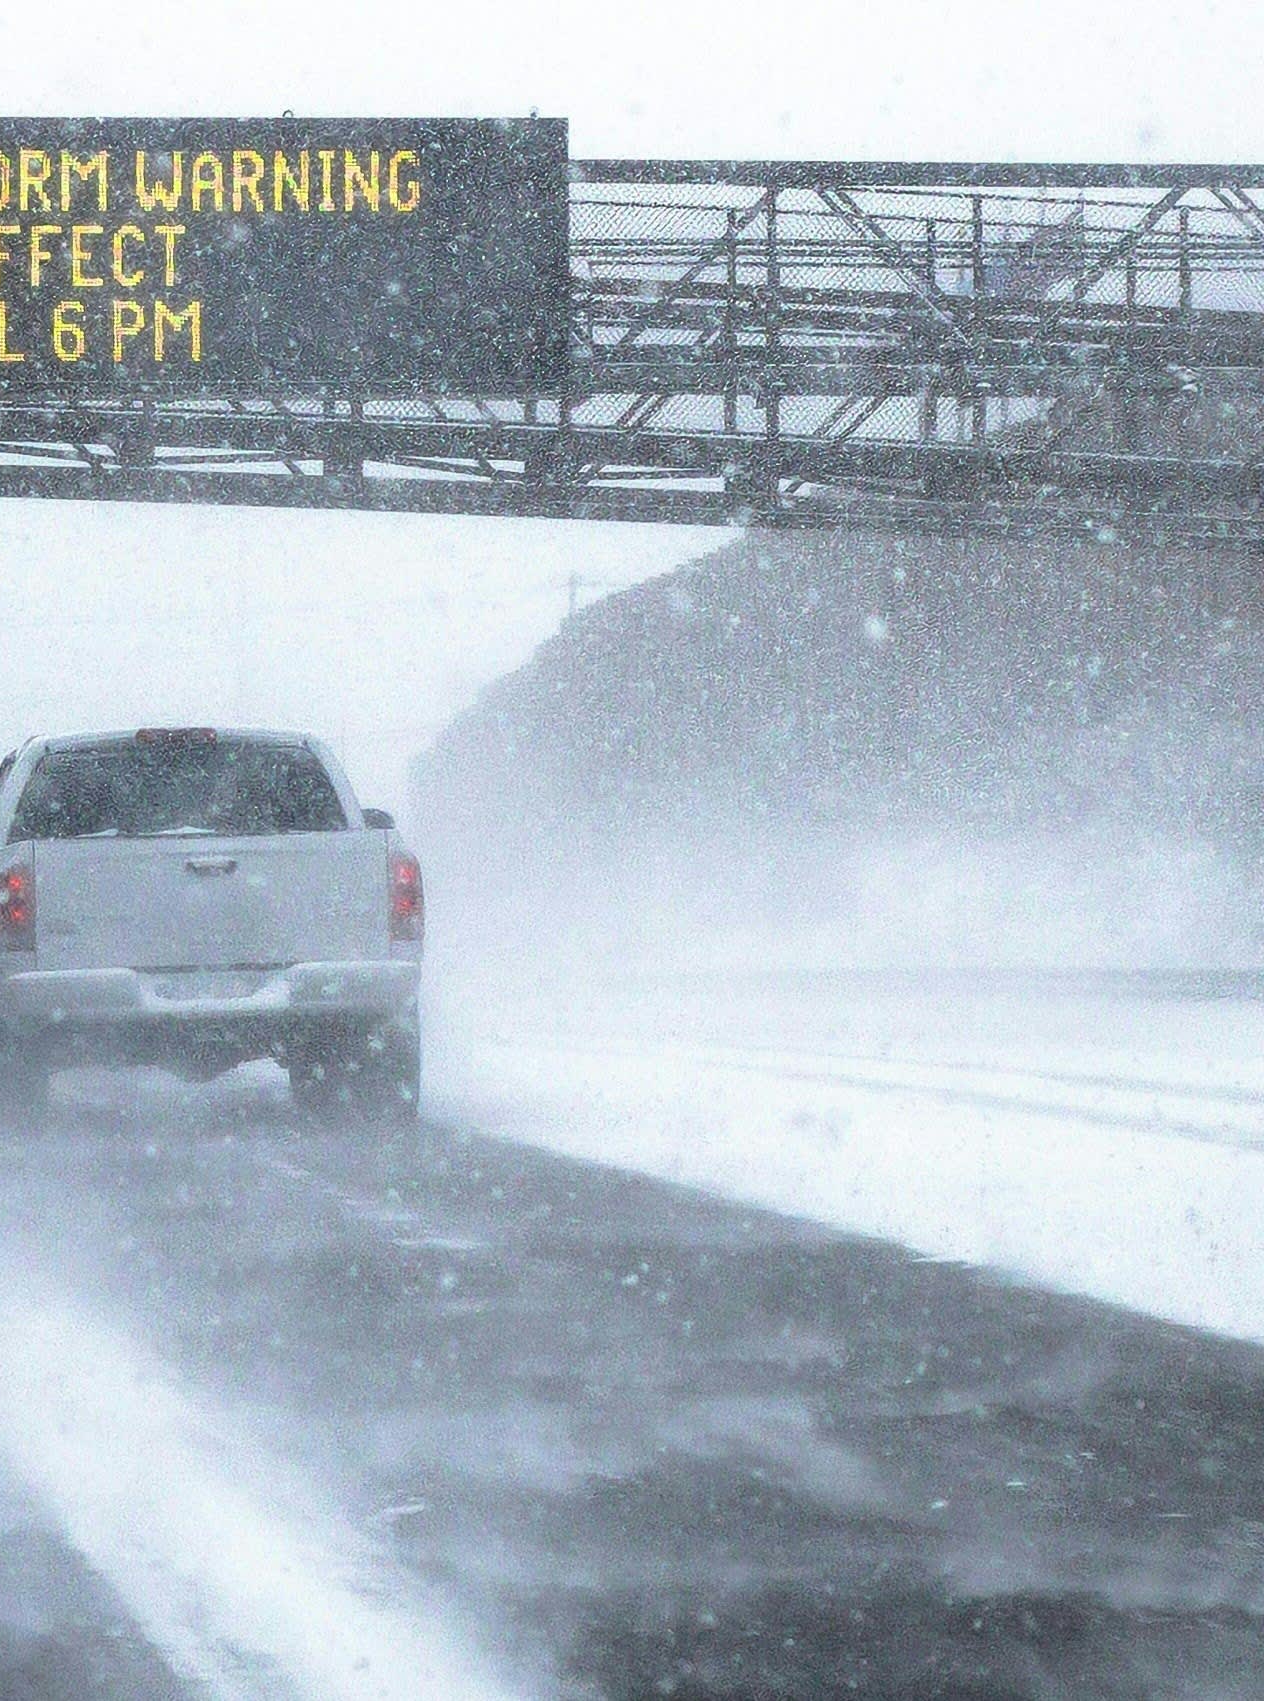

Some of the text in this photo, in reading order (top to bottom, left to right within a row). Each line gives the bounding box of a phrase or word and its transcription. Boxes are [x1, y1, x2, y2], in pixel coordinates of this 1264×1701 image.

[133, 149, 421, 213] WARNING
[50, 299, 86, 363] 6
[111, 299, 203, 362] PM
